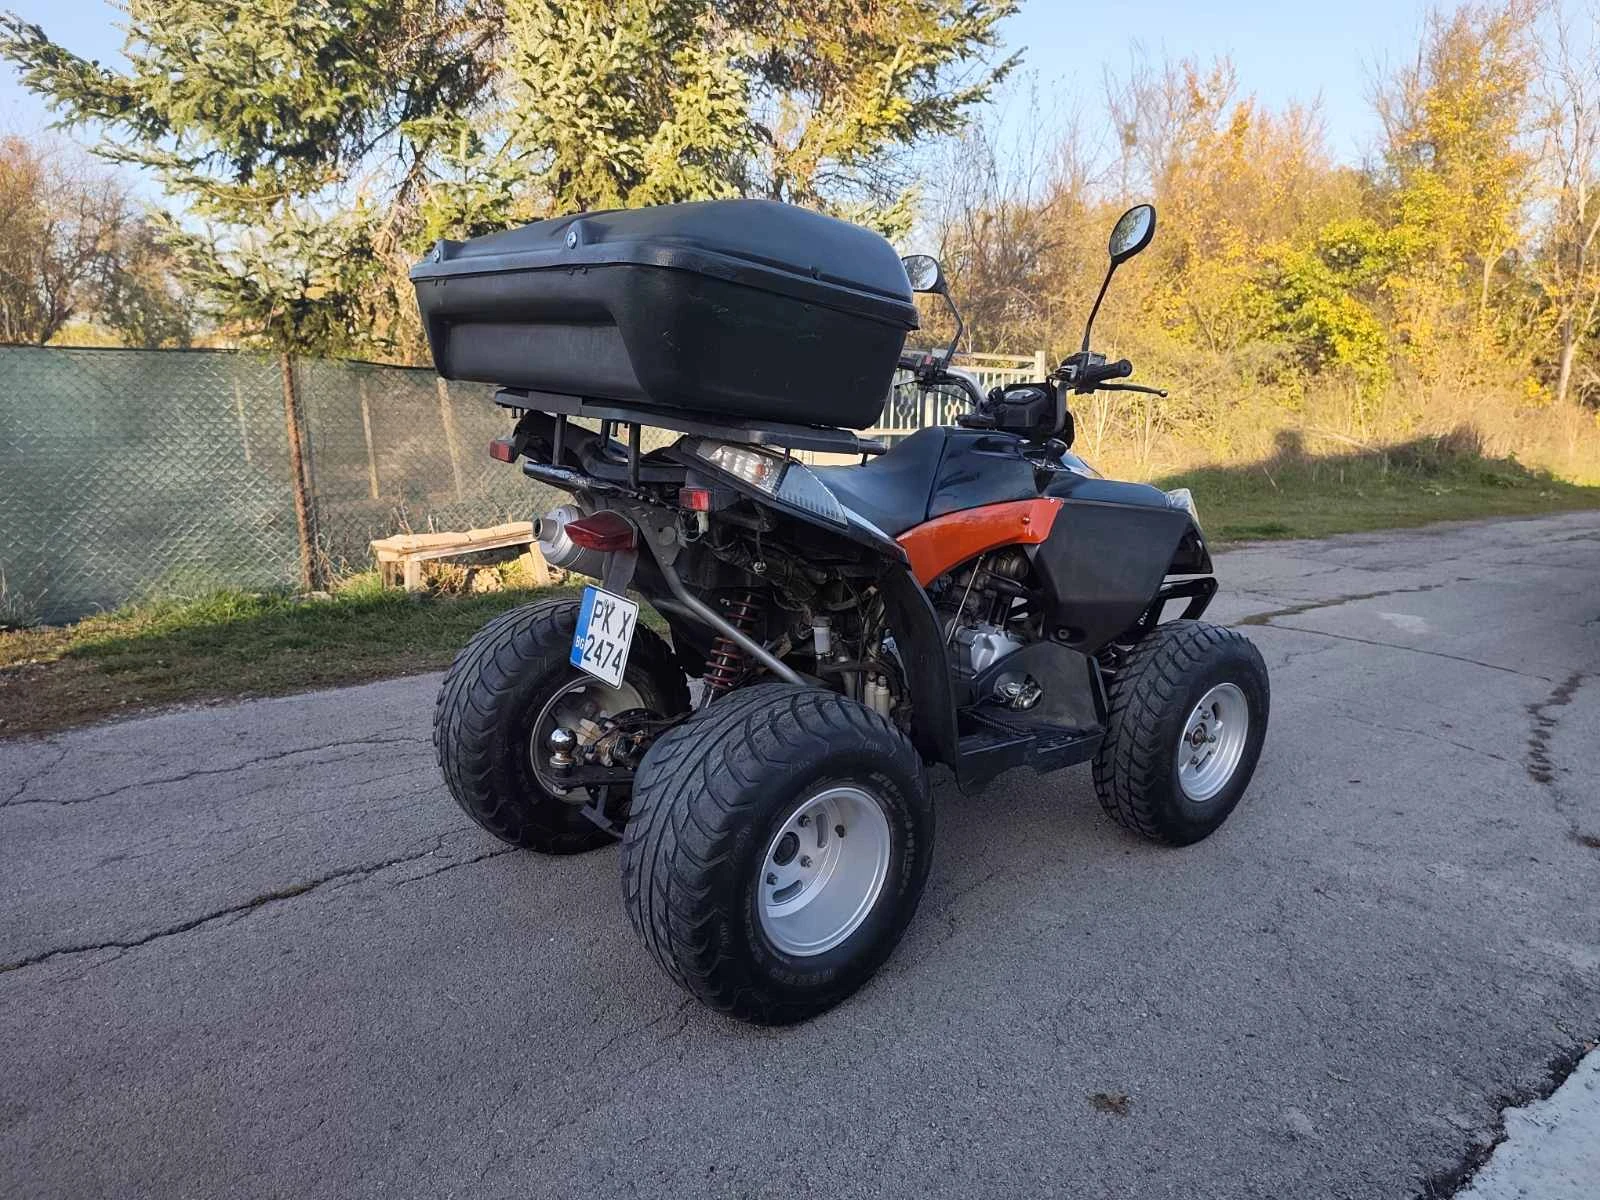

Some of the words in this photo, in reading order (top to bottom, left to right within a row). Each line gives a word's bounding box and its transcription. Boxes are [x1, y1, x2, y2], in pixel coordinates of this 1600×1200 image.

[591, 600, 616, 634] PK
[617, 611, 632, 642] X
[575, 636, 585, 650] BG
[583, 634, 624, 676] 2474
